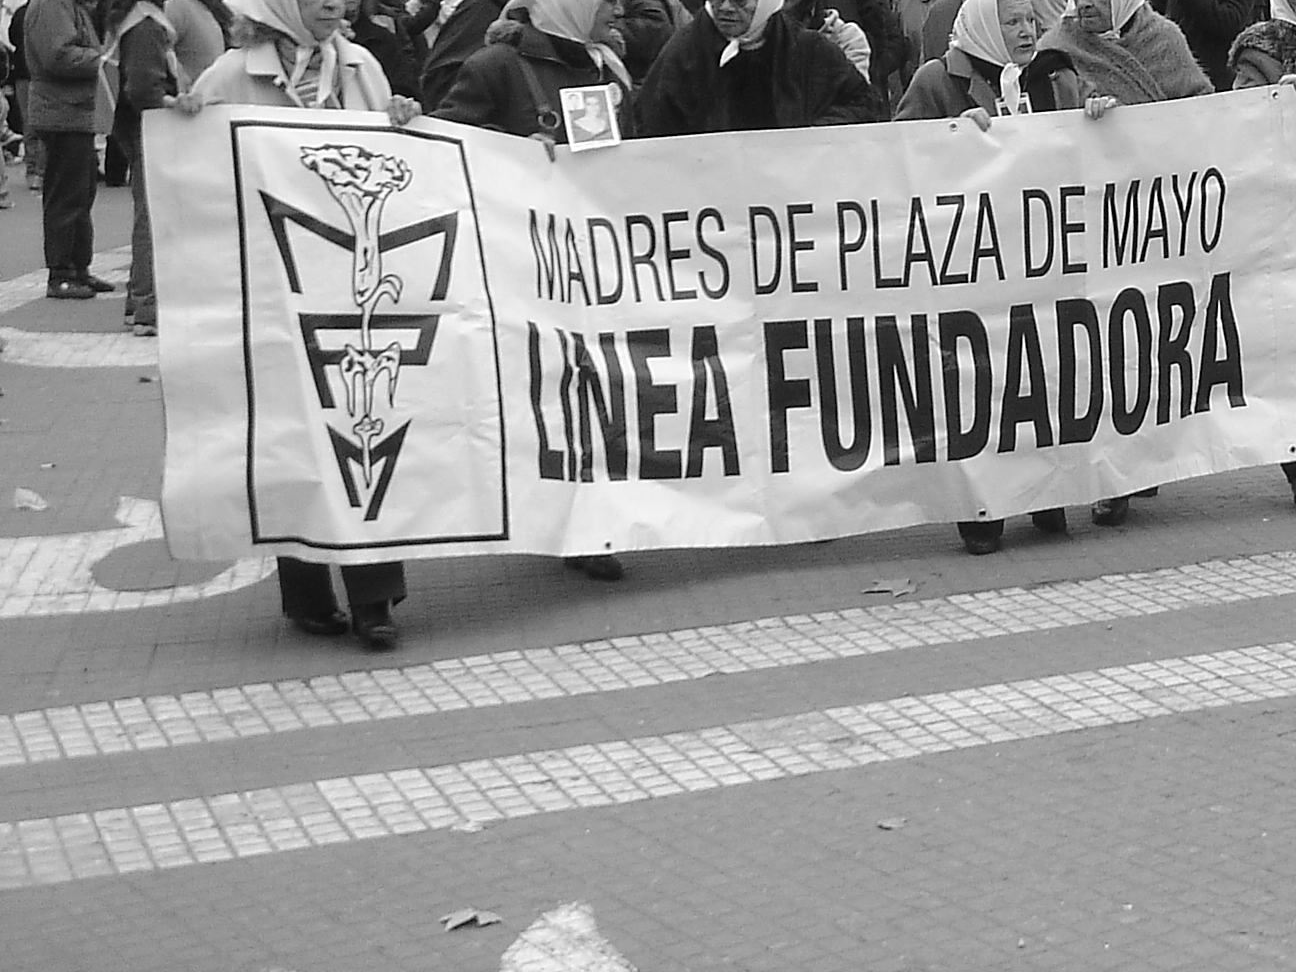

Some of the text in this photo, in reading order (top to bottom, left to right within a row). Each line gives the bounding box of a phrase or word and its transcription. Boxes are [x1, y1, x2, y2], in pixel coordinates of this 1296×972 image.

[529, 167, 1226, 307] MADRES DE PLAZA DE MAYO
[528, 272, 1247, 483] LINEA FUNDADORA
